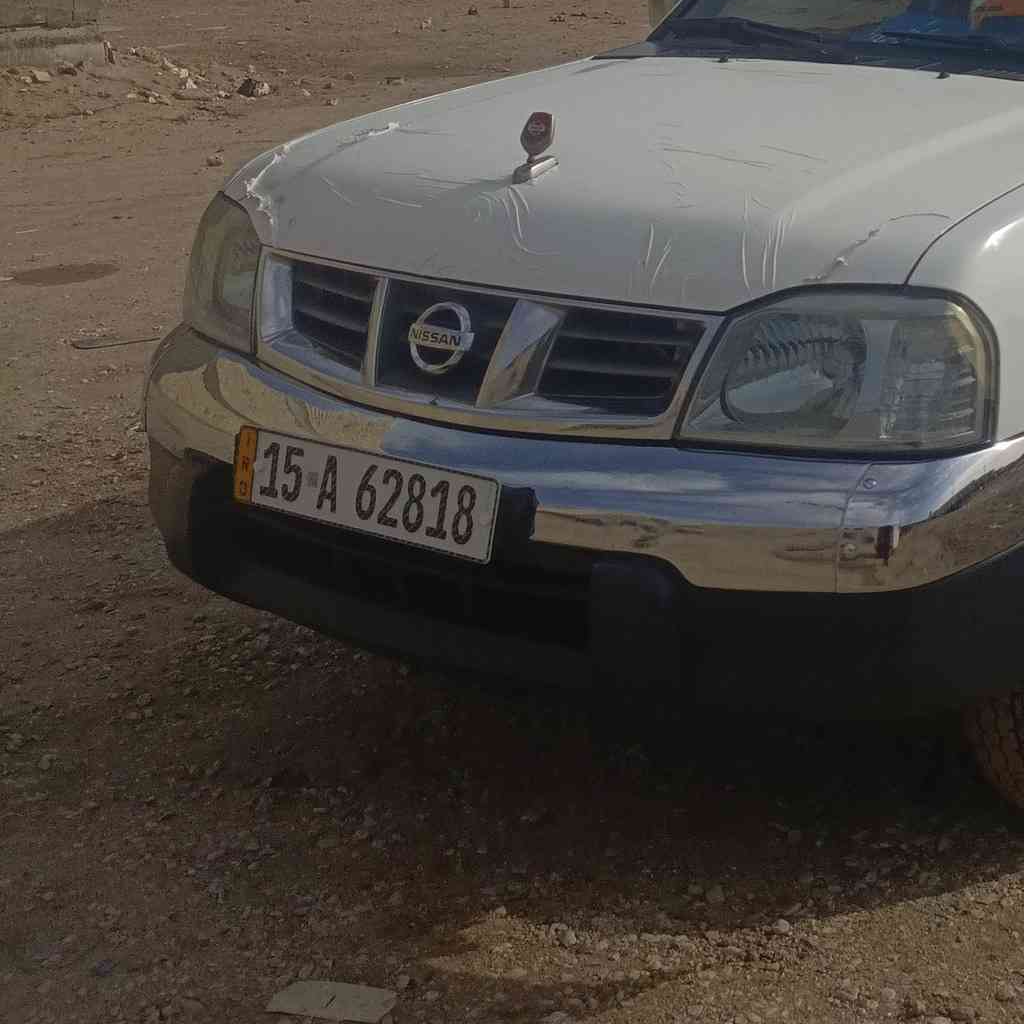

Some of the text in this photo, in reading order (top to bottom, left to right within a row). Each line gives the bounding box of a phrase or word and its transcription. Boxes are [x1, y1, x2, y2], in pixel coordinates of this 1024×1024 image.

[409, 325, 462, 347] NISSAN
[260, 442, 477, 544] 15 A 62818
